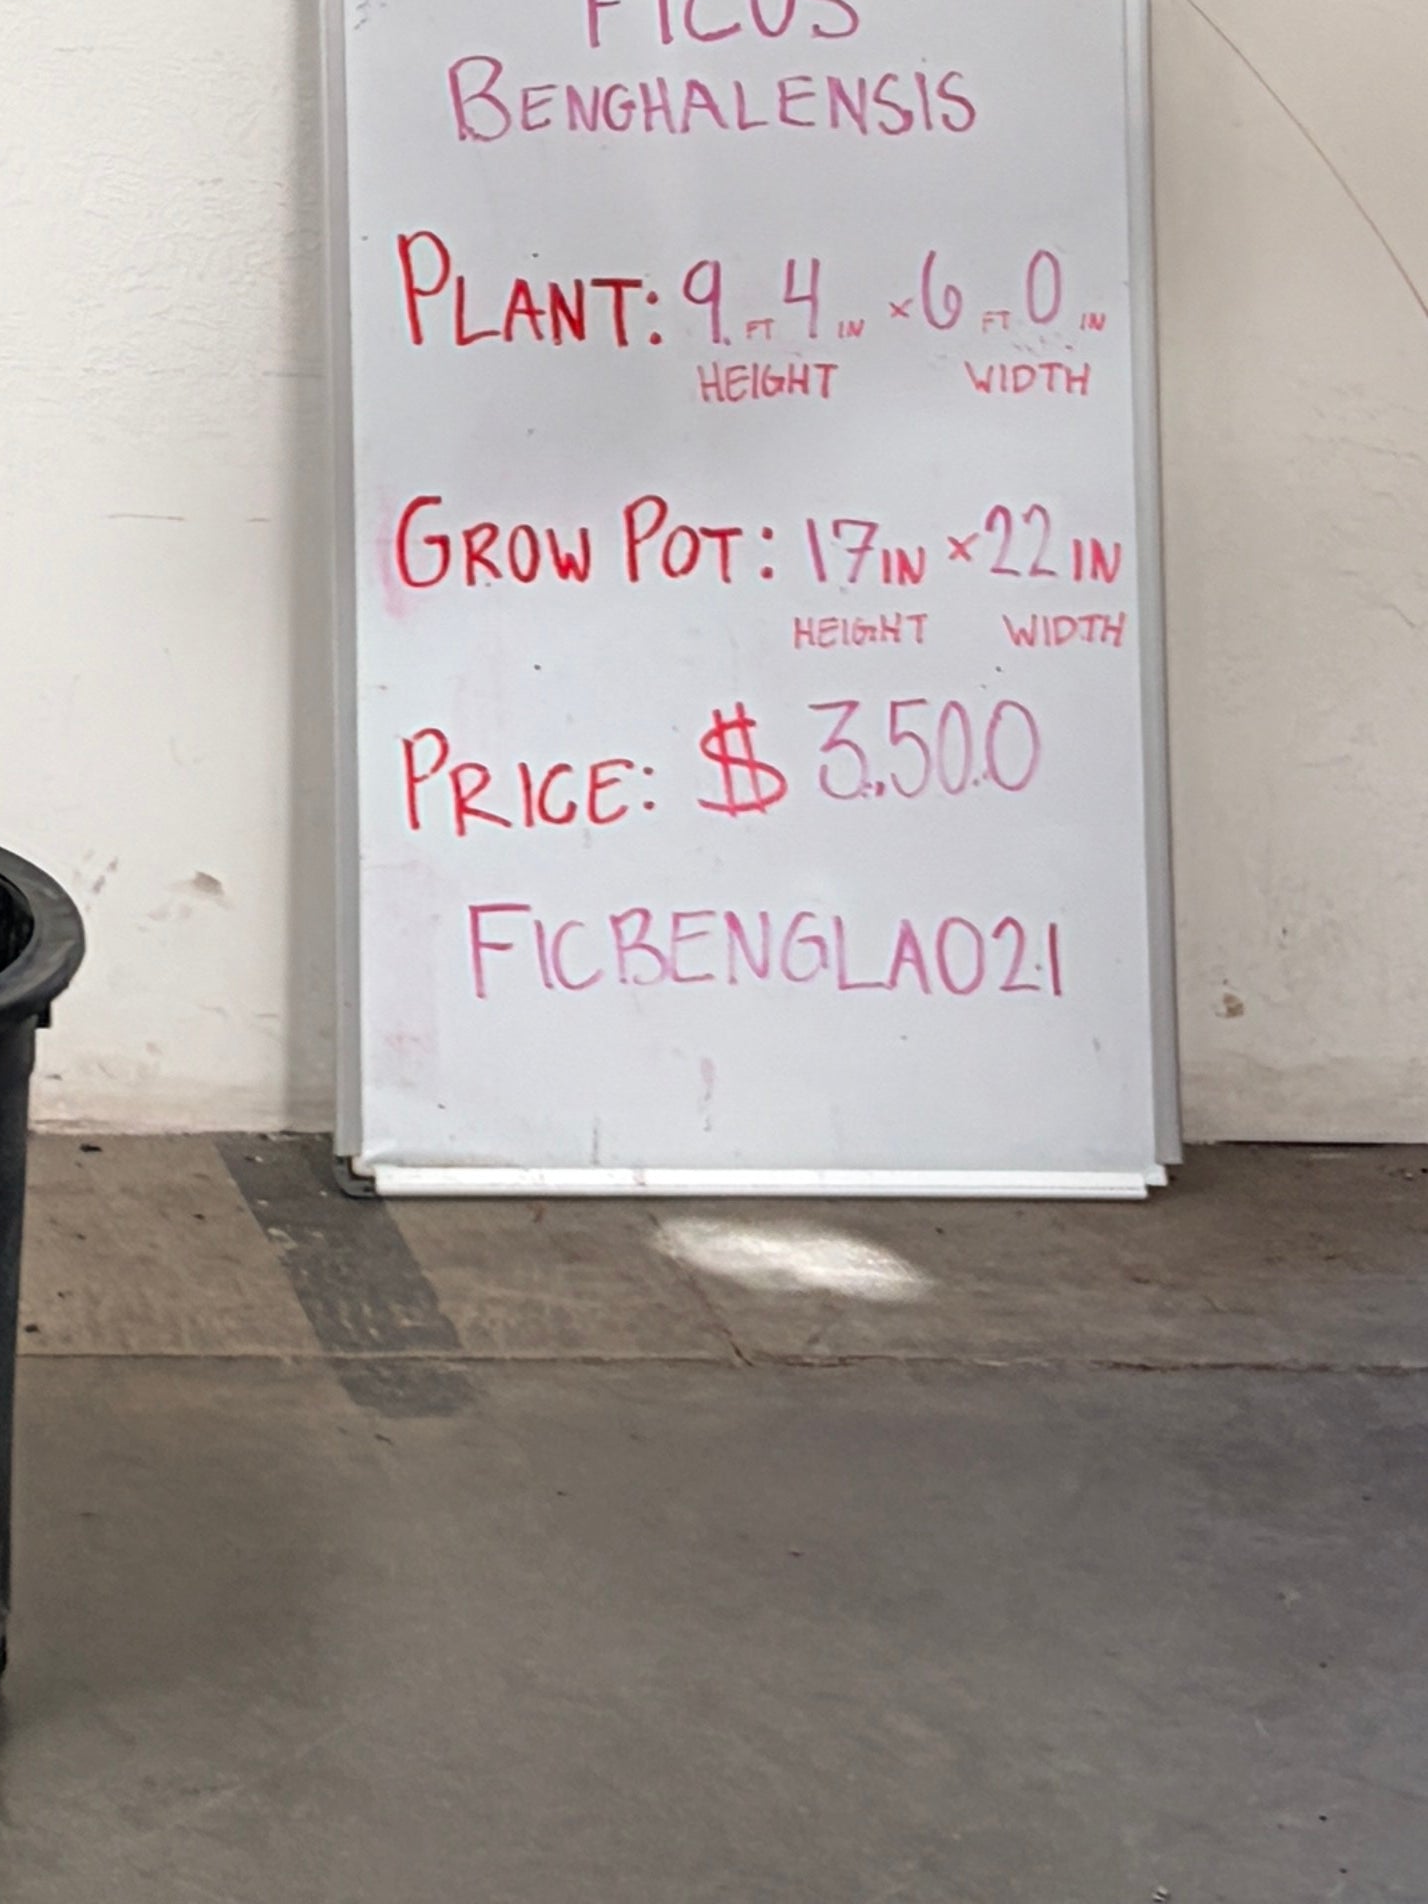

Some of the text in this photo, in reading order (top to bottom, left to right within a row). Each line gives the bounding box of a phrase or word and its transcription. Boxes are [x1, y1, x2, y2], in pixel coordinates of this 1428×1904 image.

[445, 55, 978, 145] BENGHALENSIS
[394, 228, 665, 351] PLANT:
[744, 318, 772, 336] FT
[781, 258, 822, 339] 4
[839, 318, 867, 339] IN
[919, 251, 962, 331] 6
[981, 309, 1012, 332] FT
[1025, 250, 1061, 325] 0
[1081, 312, 1107, 333] IN
[700, 360, 1093, 403] HEIGHT WIDTH
[390, 493, 594, 592] GROW
[619, 492, 776, 586] POT:
[792, 612, 1126, 649] HEIGHT WIDTH
[399, 725, 657, 840] PRICE:
